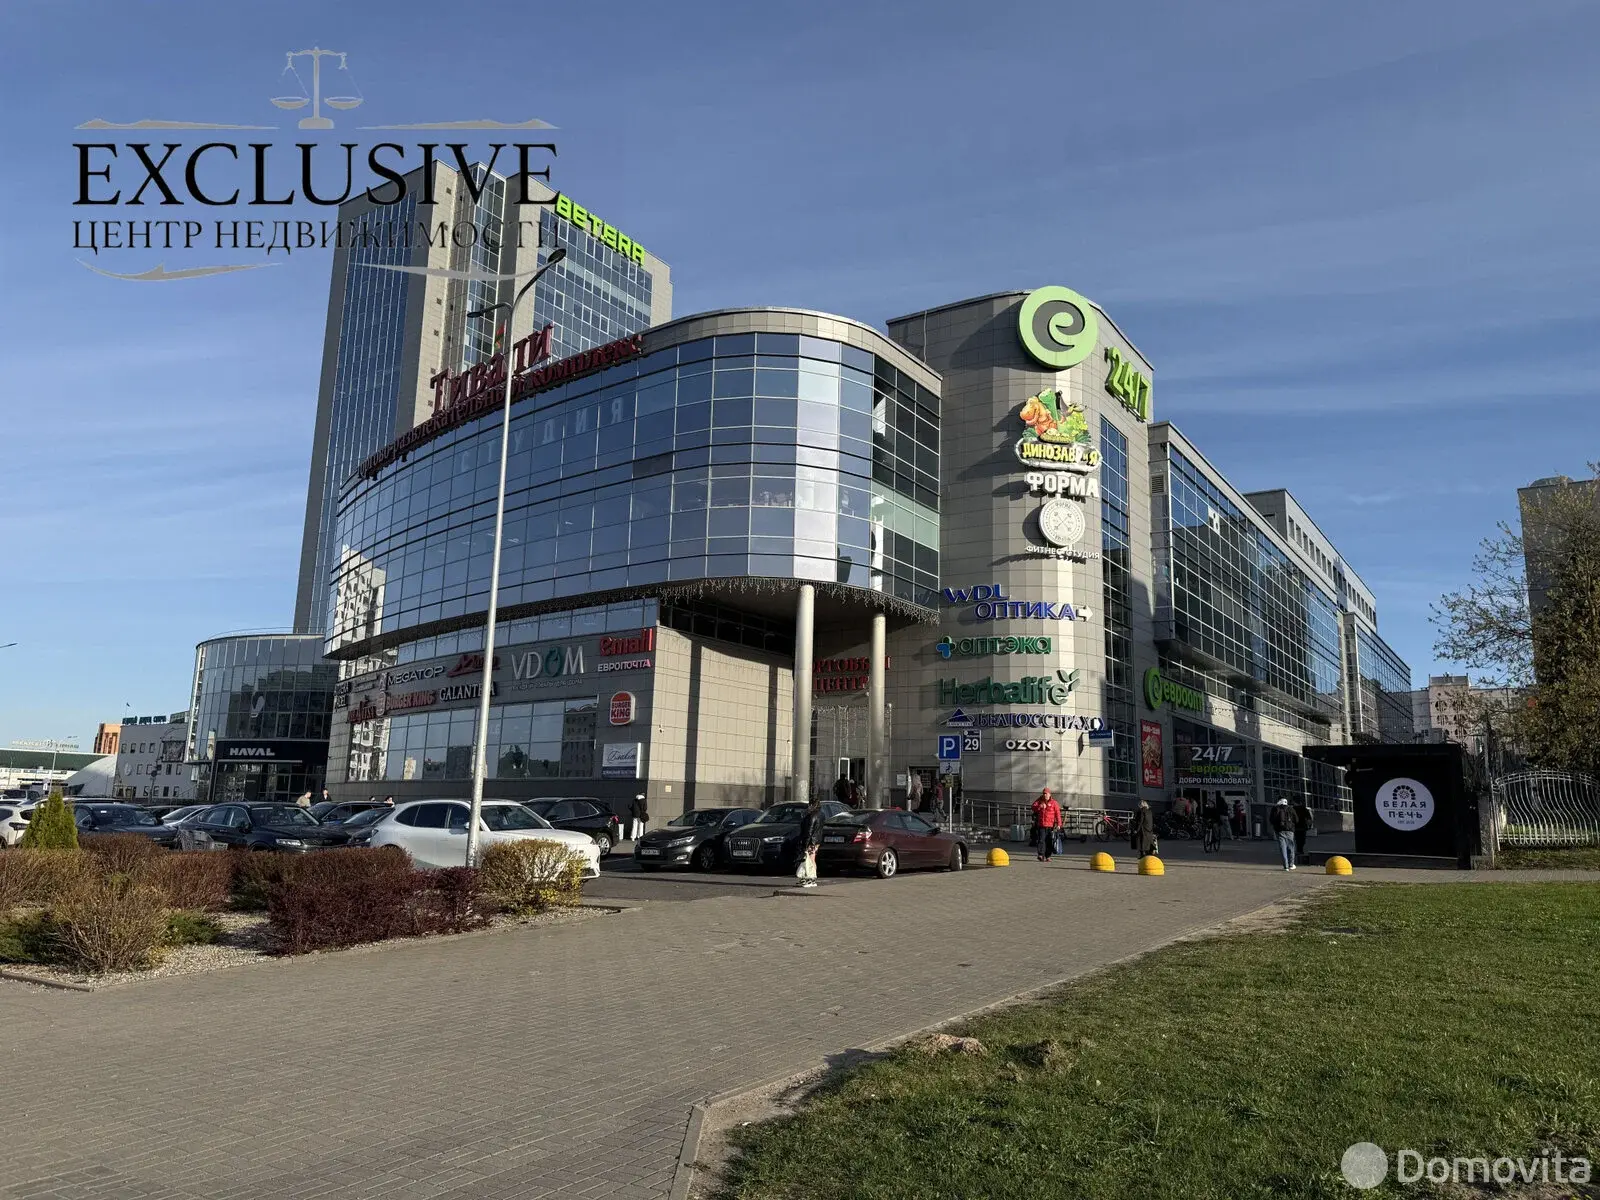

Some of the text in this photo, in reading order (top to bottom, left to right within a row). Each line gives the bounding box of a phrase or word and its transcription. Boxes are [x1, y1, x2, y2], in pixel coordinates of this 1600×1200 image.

[556, 193, 646, 266] BETERA
[1105, 346, 1151, 423] 24/7
[1024, 471, 1100, 498] ФОРМА
[944, 583, 1011, 603] WDL
[974, 601, 1077, 621] ОПТИКА
[958, 635, 1052, 655] аптэка
[597, 658, 652, 673] ЕВРОПОЧТА
[939, 675, 1069, 706] Herbalife
[611, 708, 631, 718] KING
[978, 712, 1091, 731] БЕЛГОССТРАХ
[229, 747, 275, 757] HAVAL
[964, 738, 979, 751] 29
[1006, 738, 1052, 751] OZON
[1191, 745, 1233, 762] 24/7
[1179, 777, 1202, 785] ДОБРО
[1383, 800, 1427, 809] БЕЛАЯ
